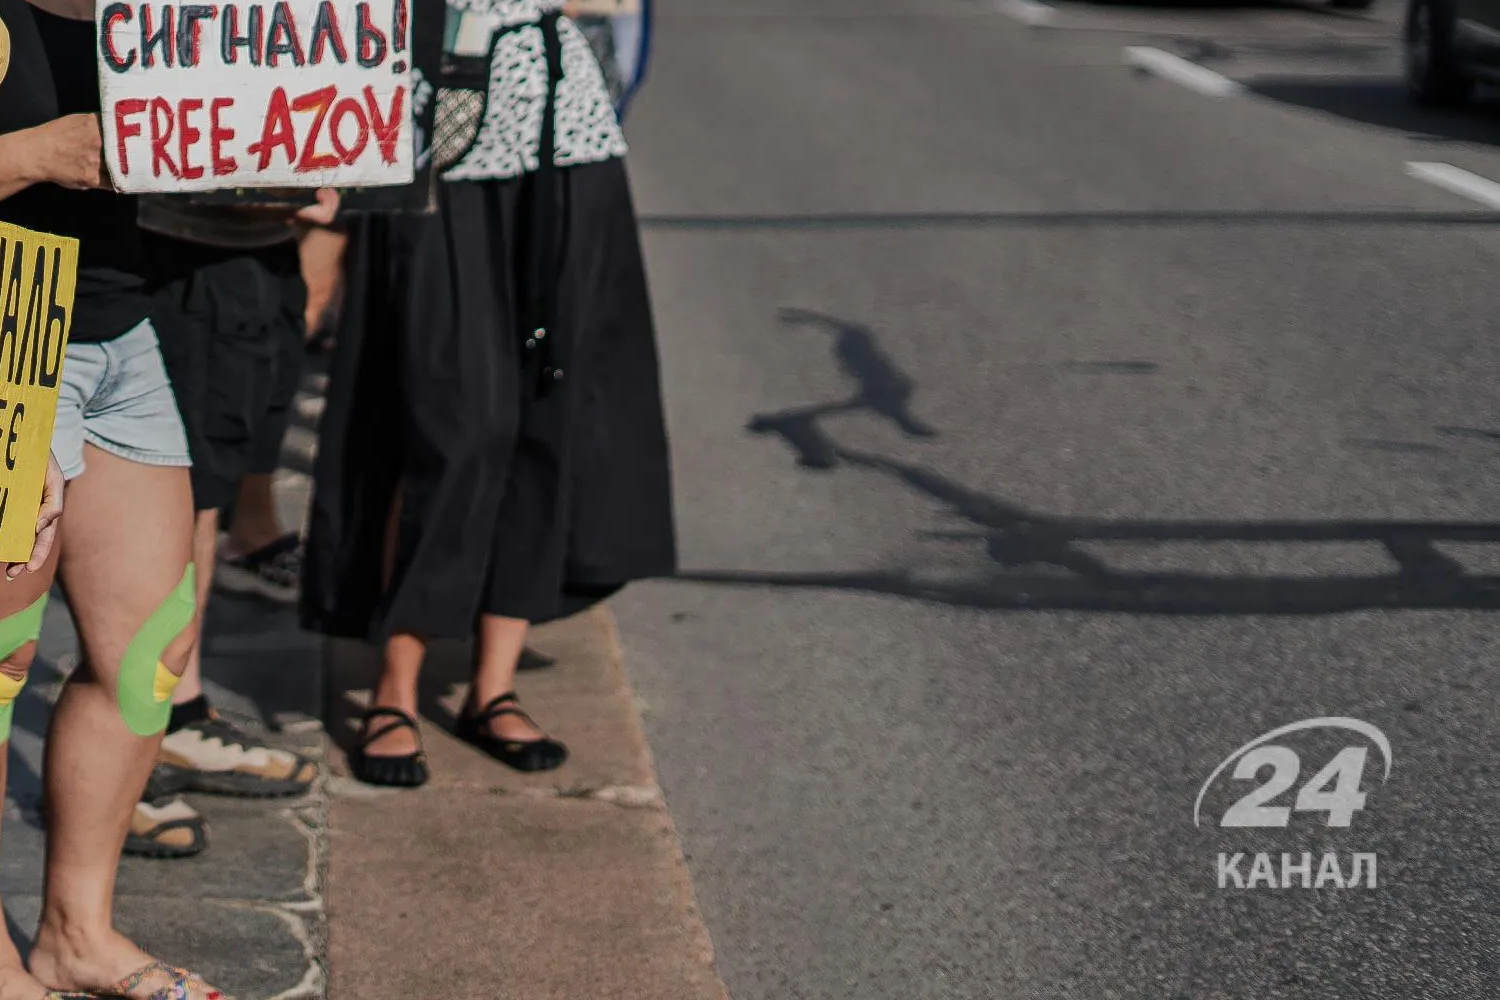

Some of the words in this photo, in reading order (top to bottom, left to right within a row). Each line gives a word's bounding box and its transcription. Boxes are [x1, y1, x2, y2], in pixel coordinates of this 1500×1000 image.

[114, 97, 238, 180] FREE
[247, 84, 405, 172] AZOV
[5, 402, 25, 471] Є
